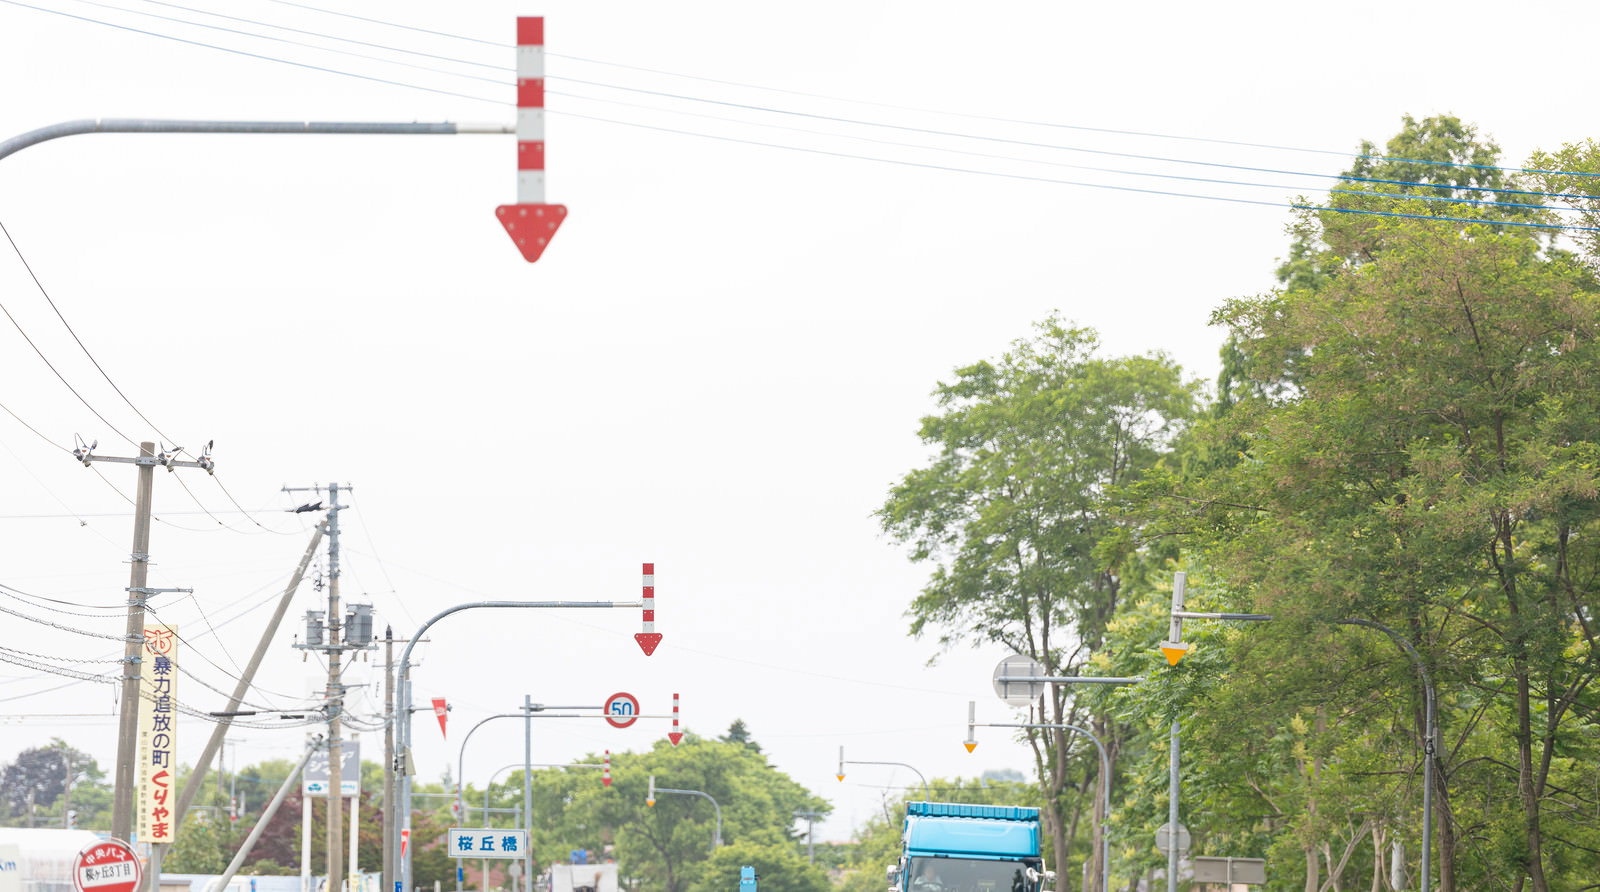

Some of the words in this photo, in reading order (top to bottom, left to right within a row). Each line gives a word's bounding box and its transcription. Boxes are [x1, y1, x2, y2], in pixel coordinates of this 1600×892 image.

[611, 701, 632, 717] 50
[458, 835, 518, 852] 桜丘橋
[85, 847, 127, 864] 中央バス
